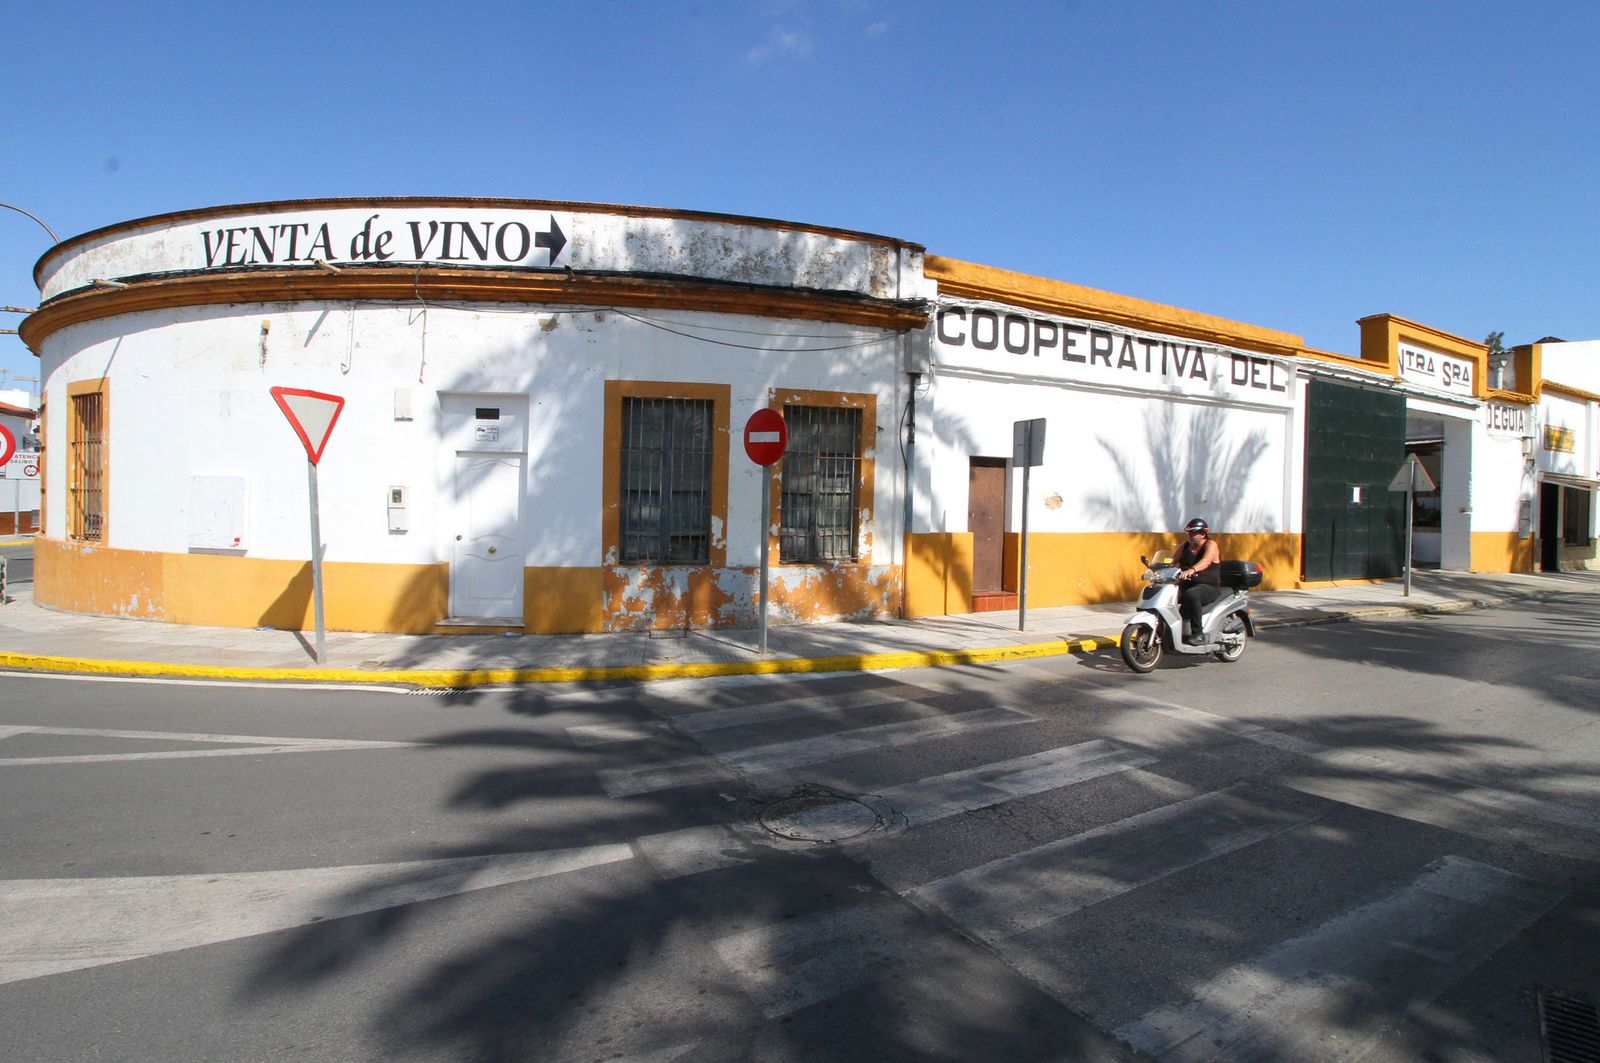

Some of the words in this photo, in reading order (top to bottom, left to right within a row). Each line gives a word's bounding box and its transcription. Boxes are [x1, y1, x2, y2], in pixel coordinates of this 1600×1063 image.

[201, 221, 338, 267] VENTA
[350, 213, 395, 261] de
[406, 220, 531, 262] VINO
[936, 304, 1208, 381] COOPERATIVA
[1231, 352, 1286, 393] DEL
